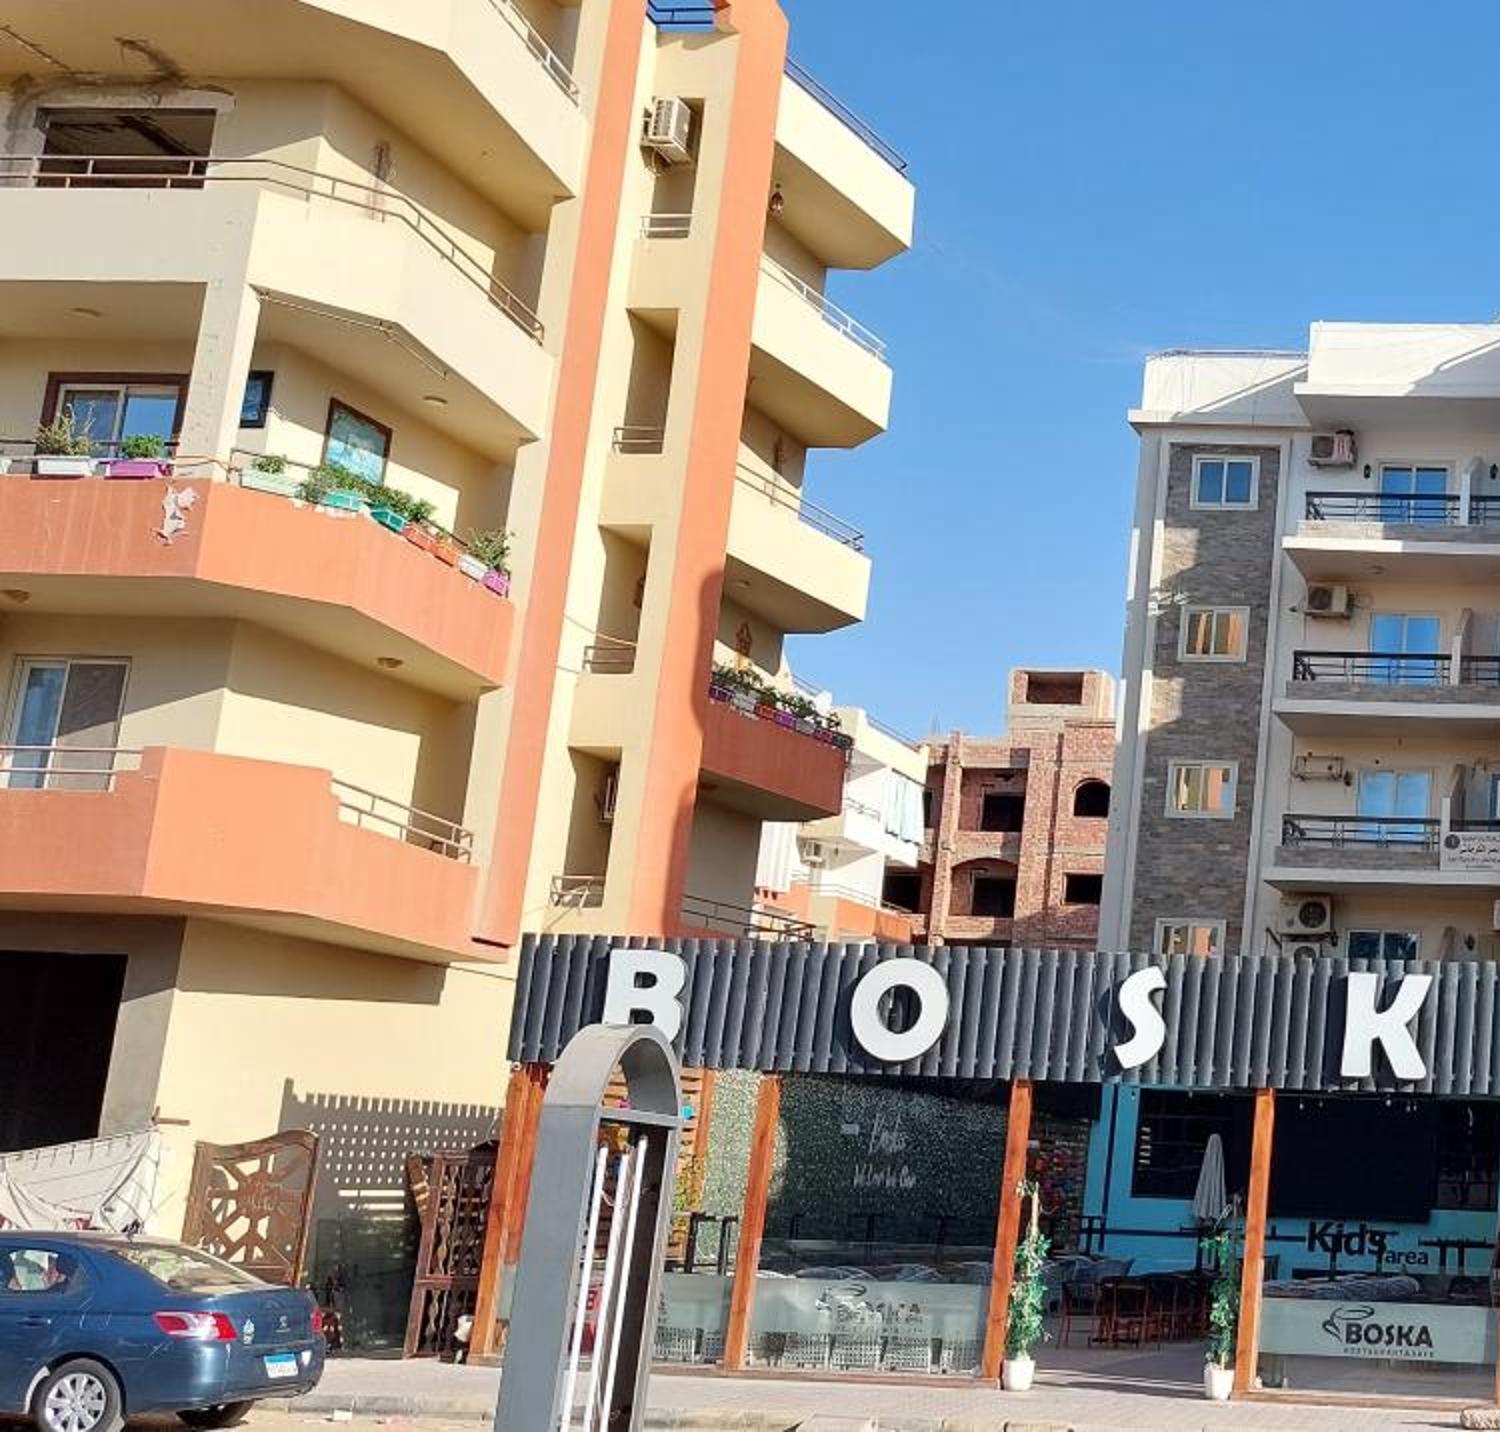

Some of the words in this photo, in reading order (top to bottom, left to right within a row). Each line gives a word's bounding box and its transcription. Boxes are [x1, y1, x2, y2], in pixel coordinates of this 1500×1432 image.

[1307, 1221, 1386, 1256] Kids
[1385, 1249, 1429, 1265] area
[1345, 1322, 1433, 1348] BOSKA
